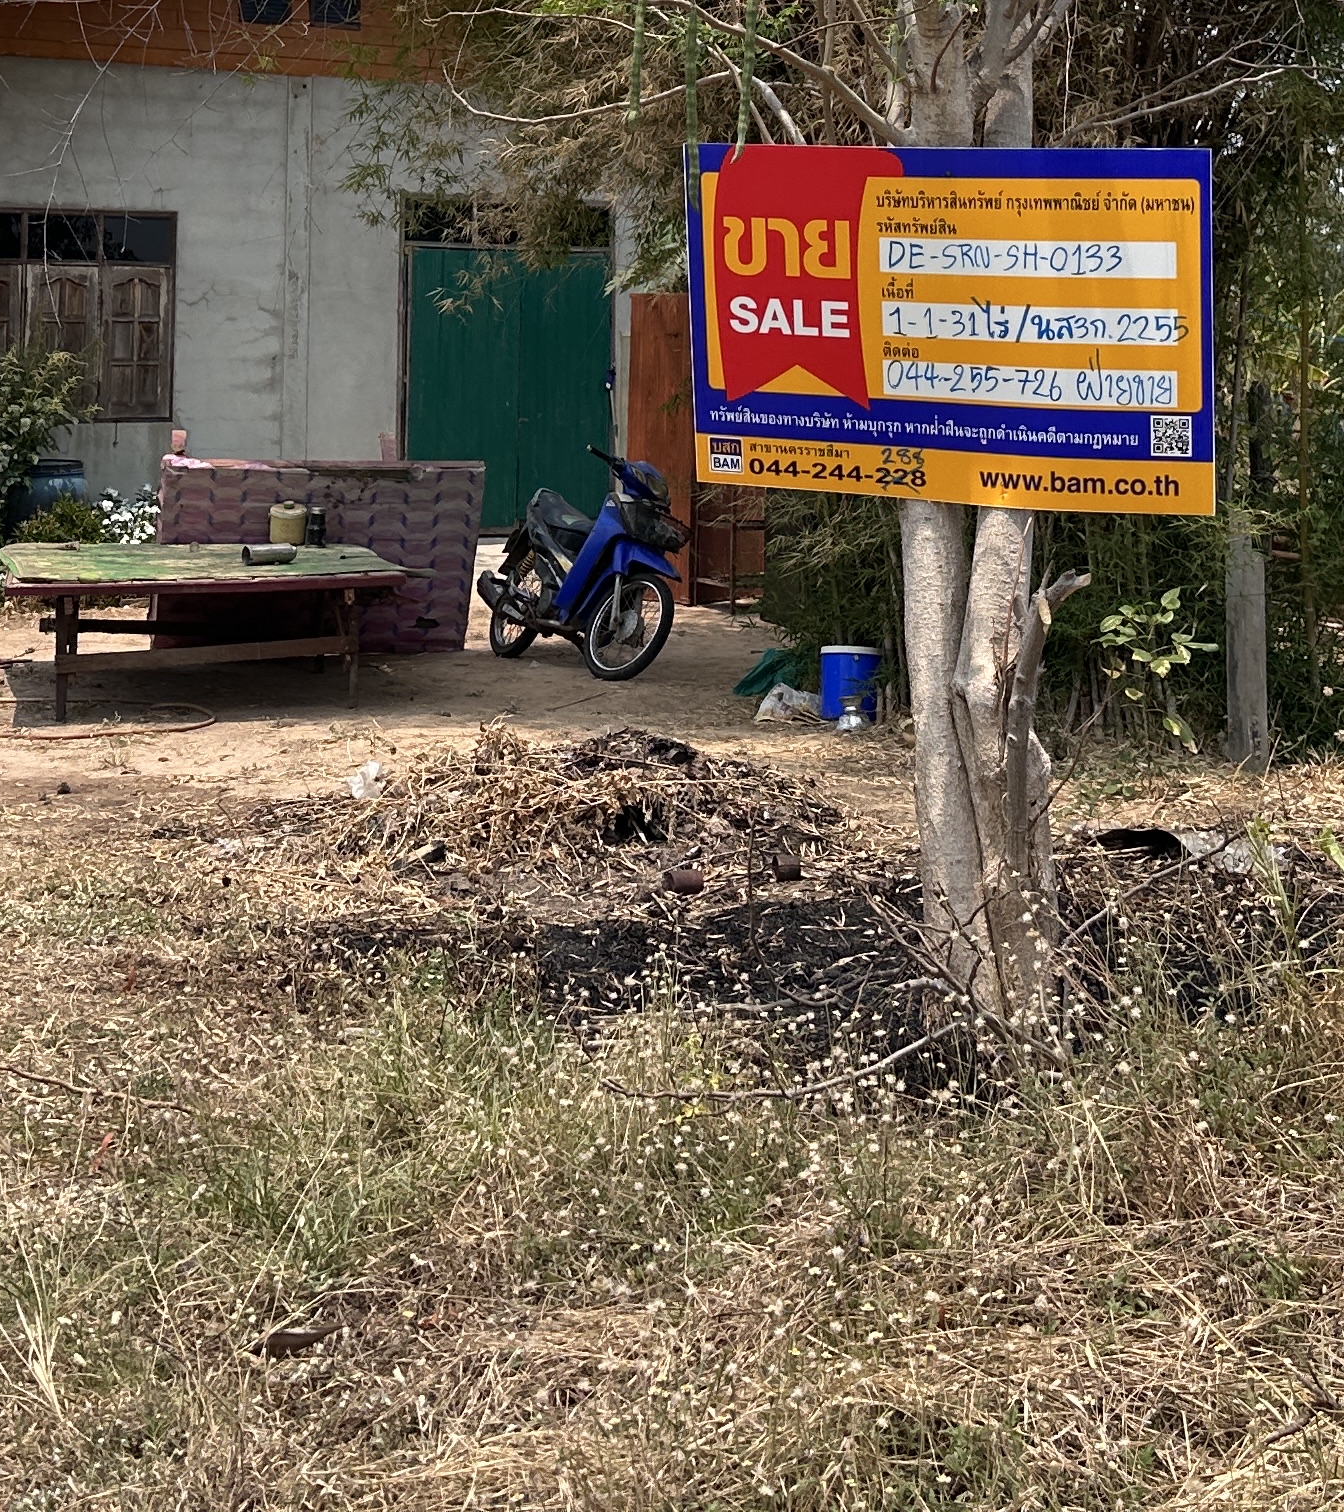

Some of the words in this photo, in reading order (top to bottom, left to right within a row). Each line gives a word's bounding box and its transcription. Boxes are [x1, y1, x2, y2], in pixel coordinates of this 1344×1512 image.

[876, 189, 1003, 210] บริษัทบริหารสินทรัพย์
[1006, 190, 1102, 217] กรุงเทพพาณิชย์
[1103, 192, 1137, 211] จำกัด
[1140, 196, 1195, 215] (มหาชน)
[876, 216, 957, 235] รหัสทรัพย์สิน
[722, 216, 852, 280] ขาย
[888, 240, 1123, 275] DE-SRN-SH-0133
[881, 276, 915, 299] เนื้อที่
[729, 295, 851, 338] SALE
[882, 340, 920, 359] ติดต่อ
[887, 359, 1062, 402] 044-255-726
[709, 405, 840, 429] ทรัพย์สินของทางบริษัท
[842, 412, 902, 438] ห้ามบุกรุก
[712, 441, 740, 454] บสก
[749, 442, 851, 459] สาขานครราชสีมา
[713, 457, 741, 470] BAM
[979, 470, 1180, 497] www.bam.co.th
